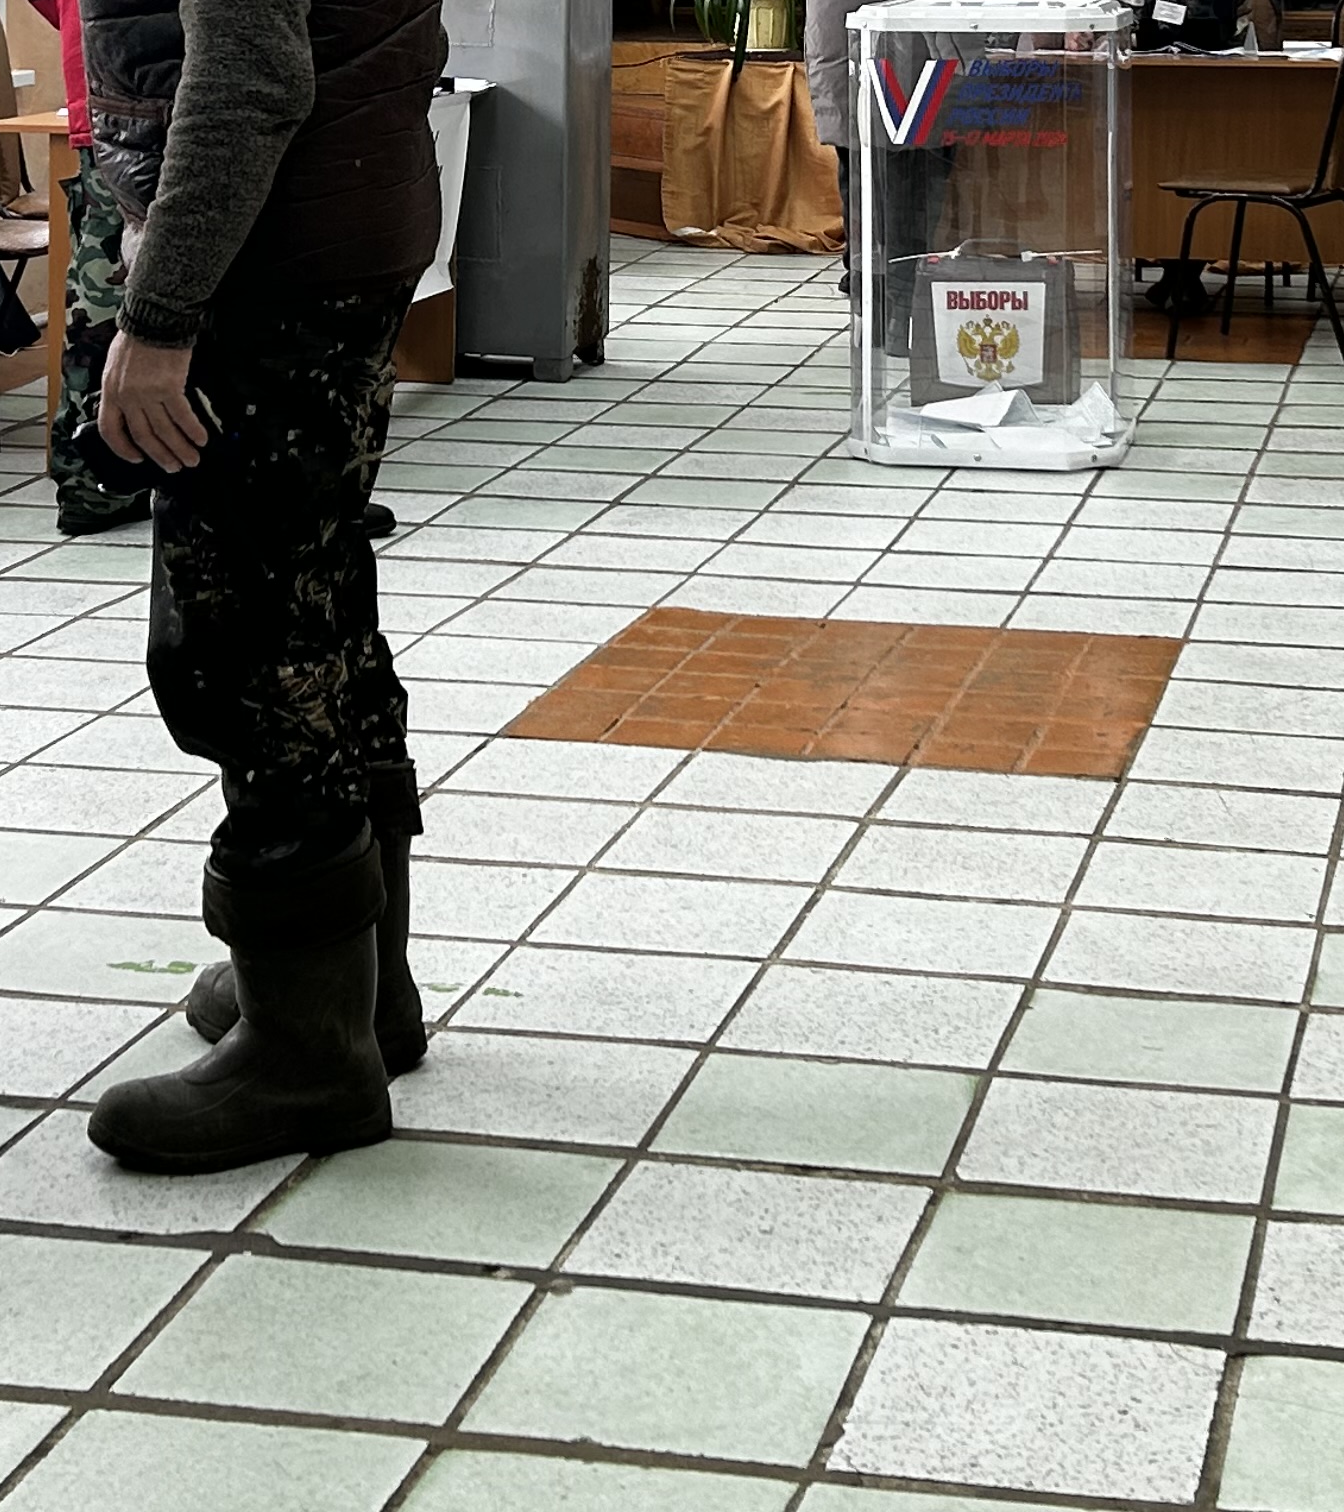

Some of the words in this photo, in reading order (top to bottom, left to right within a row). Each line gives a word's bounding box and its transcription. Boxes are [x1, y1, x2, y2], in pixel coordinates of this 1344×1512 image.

[968, 59, 1061, 77] ВЫБОРЫ
[956, 82, 1084, 102] ПРЕЗИДЕНТА
[946, 290, 1029, 311] ВЫБОРЫ
